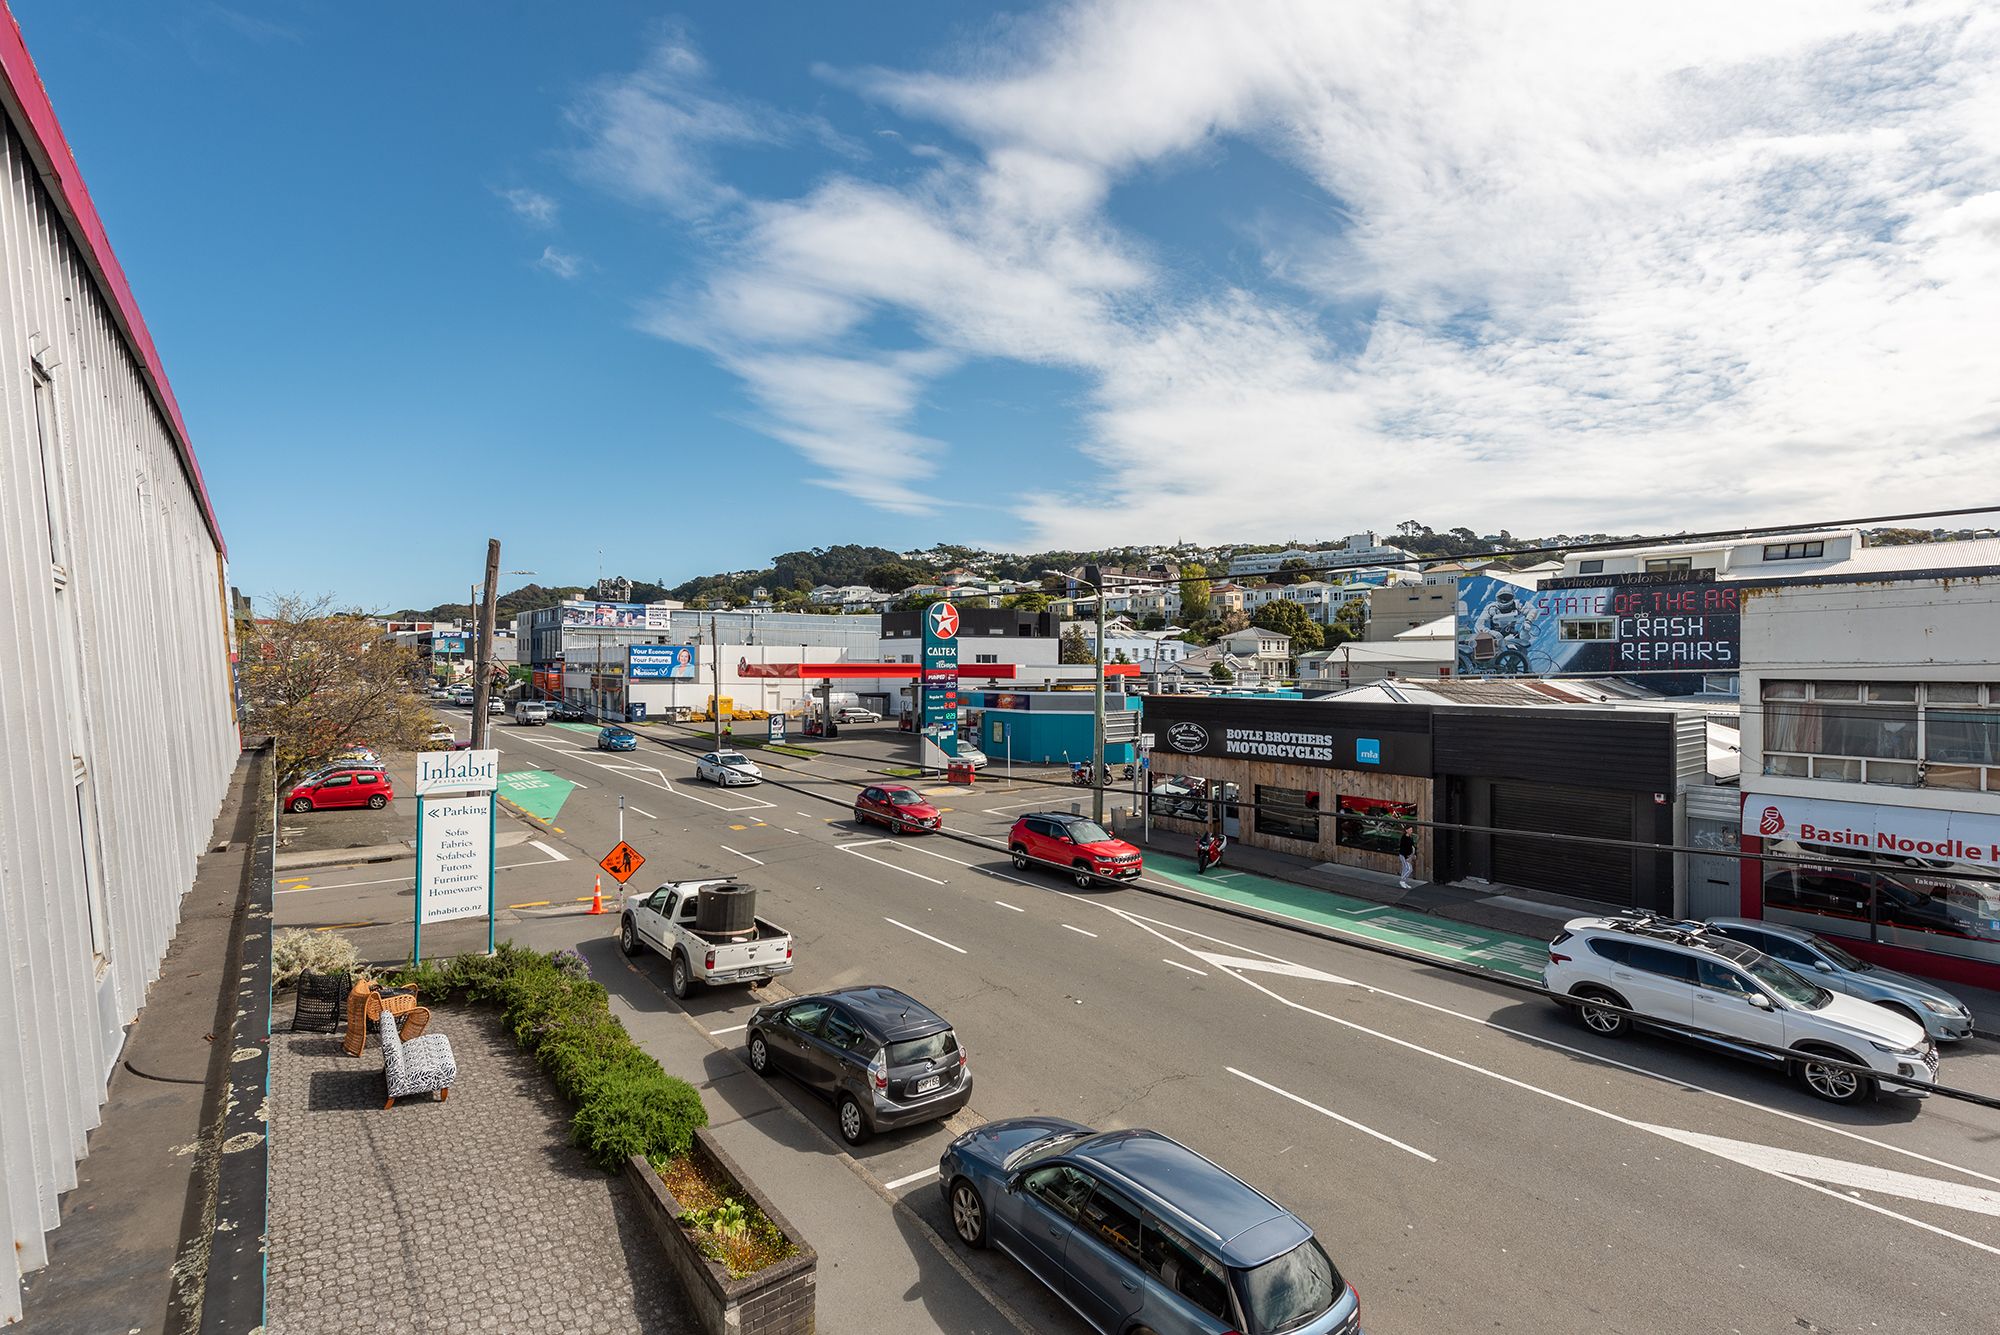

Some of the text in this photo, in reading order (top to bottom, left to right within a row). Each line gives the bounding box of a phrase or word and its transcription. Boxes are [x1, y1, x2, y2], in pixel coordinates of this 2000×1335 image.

[1557, 570, 1690, 589] Arlington Motors Ltd
[1538, 596, 1607, 616] STATE
[1615, 594, 1643, 612] OF
[1652, 591, 1697, 611] THE
[1621, 617, 1704, 638] CRASH
[927, 647, 957, 656] CALTEX
[1621, 641, 1732, 661] REPAIRS
[1226, 728, 1333, 746] BOYLE BROTHERS
[1226, 740, 1333, 761] MOTORCYCLES
[422, 753, 495, 781] Inhabit
[443, 805, 487, 817] Parking
[445, 828, 469, 837] Sofas
[441, 840, 473, 849] Fabrics
[1800, 823, 1869, 847] Basin
[1877, 832, 1982, 860] Noodle
[436, 850, 477, 861] Sofabeds
[441, 864, 472, 873] Futons
[434, 875, 479, 885] Furniture
[1914, 878, 1956, 889] Takeaway
[429, 886, 483, 897] Homewares
[428, 904, 482, 917] inhabit.co.nz
